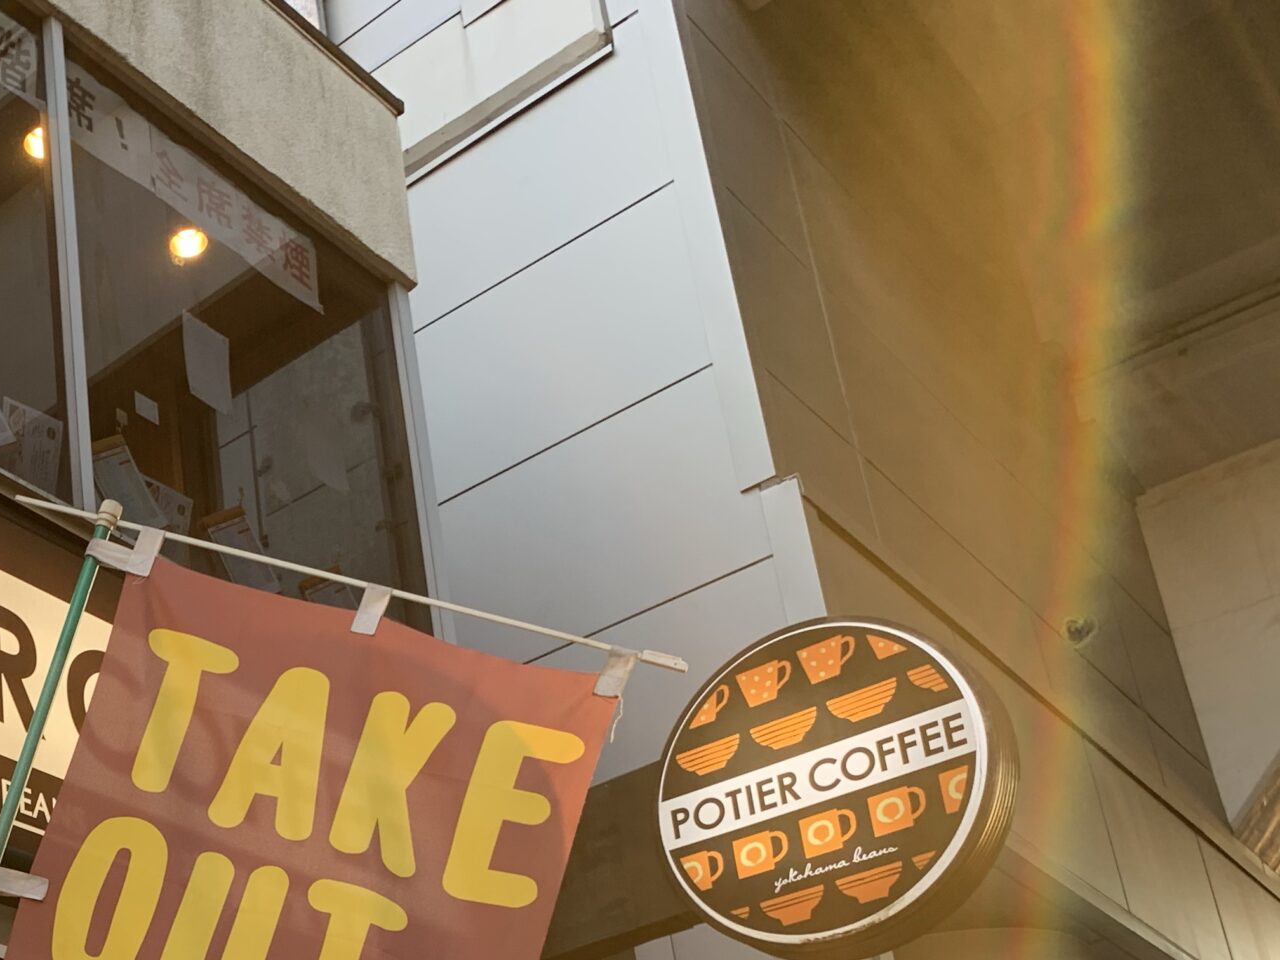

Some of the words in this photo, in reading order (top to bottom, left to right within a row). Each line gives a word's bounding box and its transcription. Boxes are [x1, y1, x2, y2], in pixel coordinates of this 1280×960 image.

[131, 628, 585, 908] TAKE
[670, 772, 801, 840] POTIER
[808, 712, 968, 792] COFFEE
[774, 857, 850, 893] yokohama
[852, 845, 898, 865] beans
